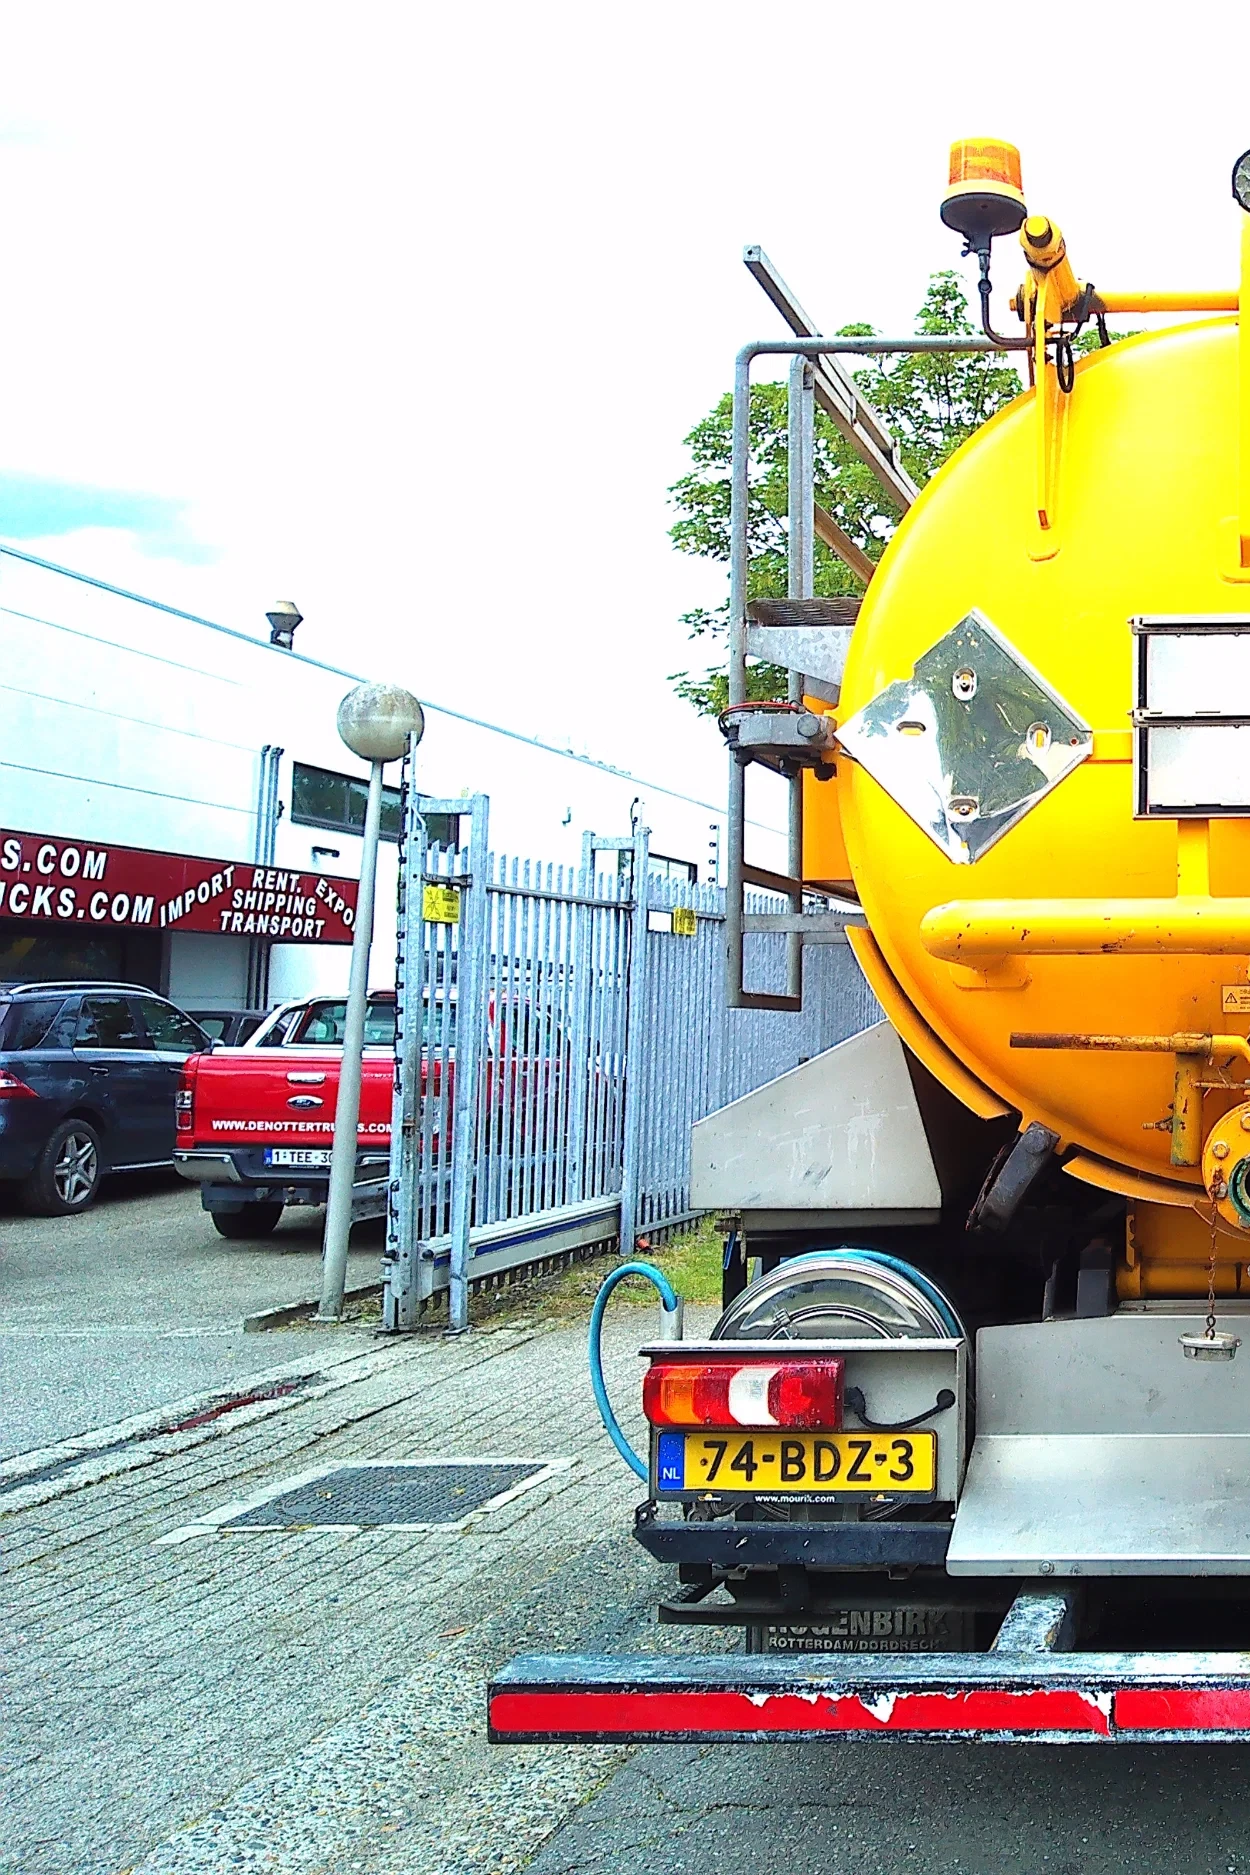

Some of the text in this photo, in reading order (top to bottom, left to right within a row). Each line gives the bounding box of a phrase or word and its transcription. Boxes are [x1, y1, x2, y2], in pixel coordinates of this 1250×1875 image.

[252, 868, 302, 893] RENT.
[160, 865, 235, 928] IMPORT
[232, 888, 317, 916] SHIPPING
[315, 878, 356, 932] EXPO
[220, 911, 325, 938] TRANSPORT
[662, 1467, 681, 1480] NL
[703, 1440, 914, 1482] 74-BDZ-3
